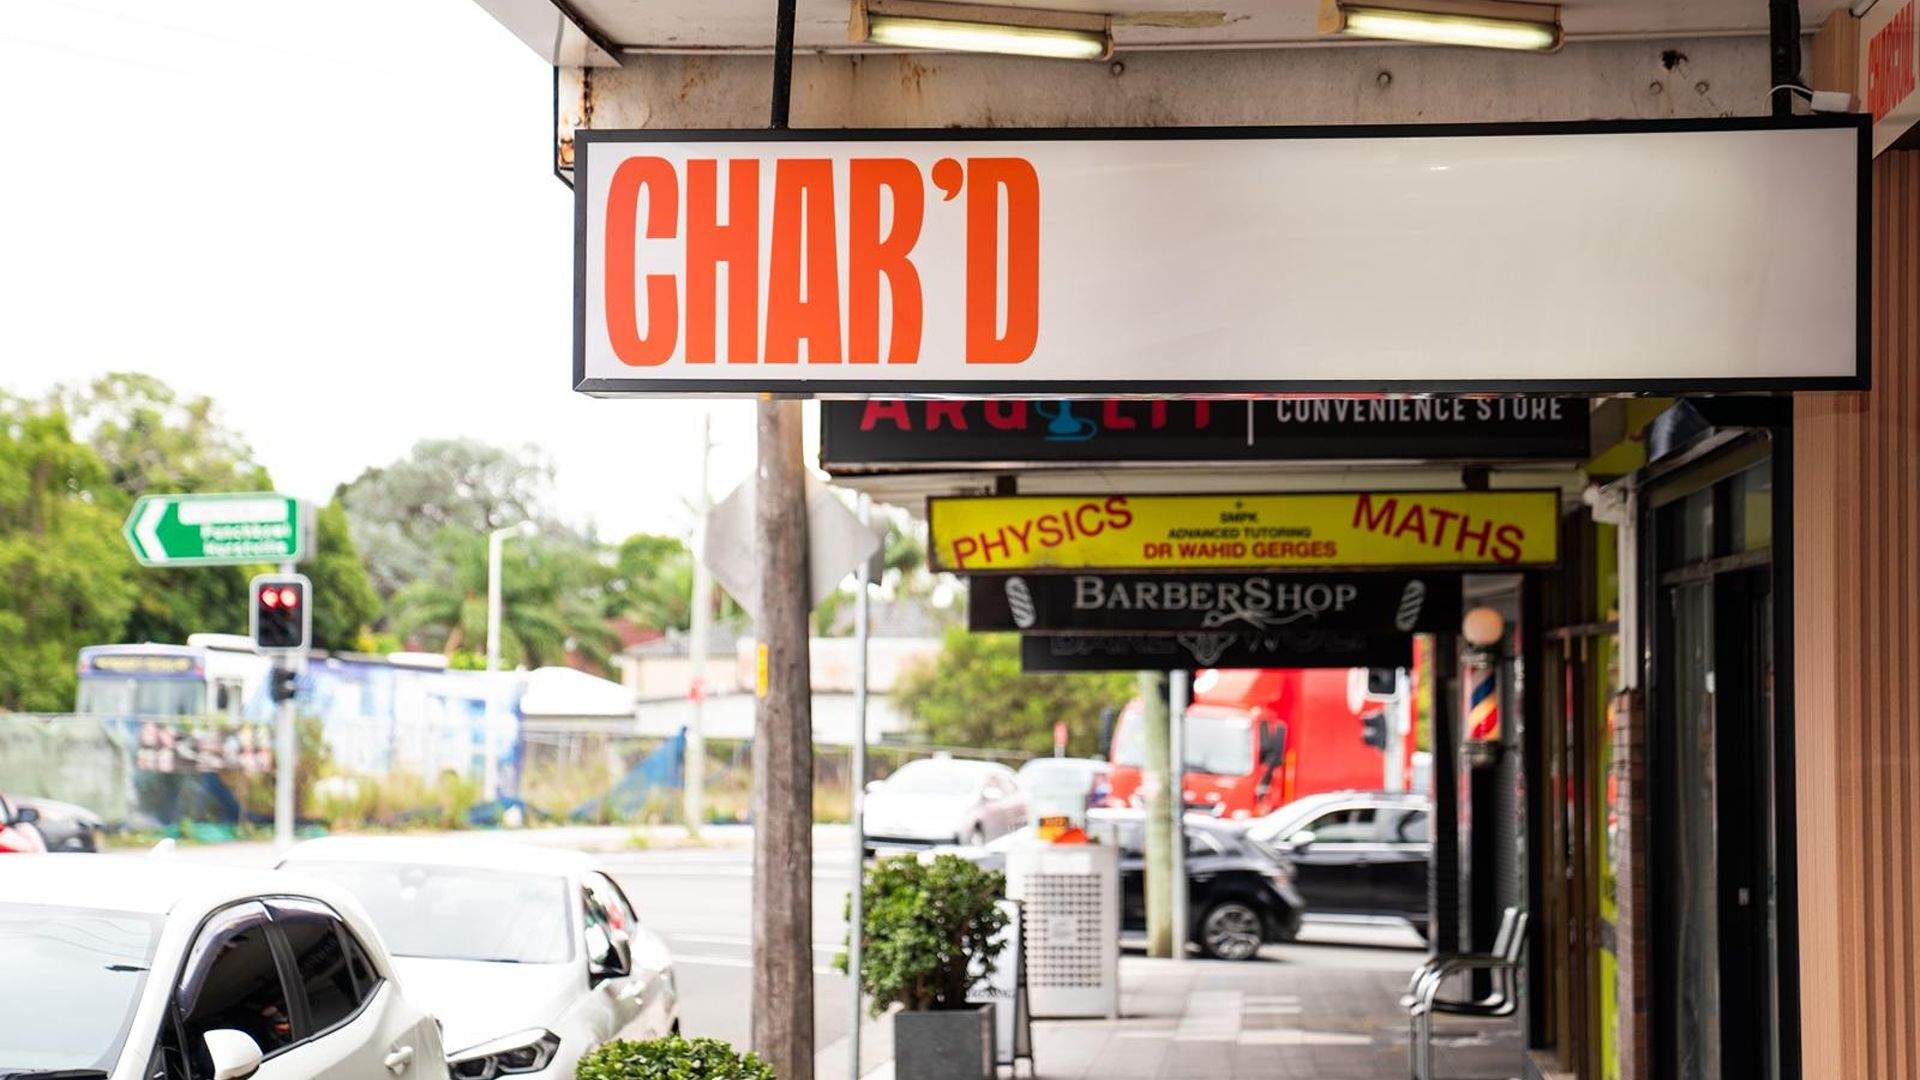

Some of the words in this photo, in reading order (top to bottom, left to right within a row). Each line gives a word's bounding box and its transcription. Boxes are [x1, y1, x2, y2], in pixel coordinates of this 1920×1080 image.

[1277, 398, 1465, 422] CONVENIENCE
[1476, 397, 1562, 421] STORE
[953, 495, 1133, 568] PHYSICS
[1168, 527, 1240, 539] ADVANCED
[1244, 526, 1311, 538] TUTORING
[1352, 494, 1525, 564] MATHS
[1143, 543, 1172, 559] DR
[1178, 542, 1246, 558] WAHID
[1252, 541, 1338, 558] GERGES
